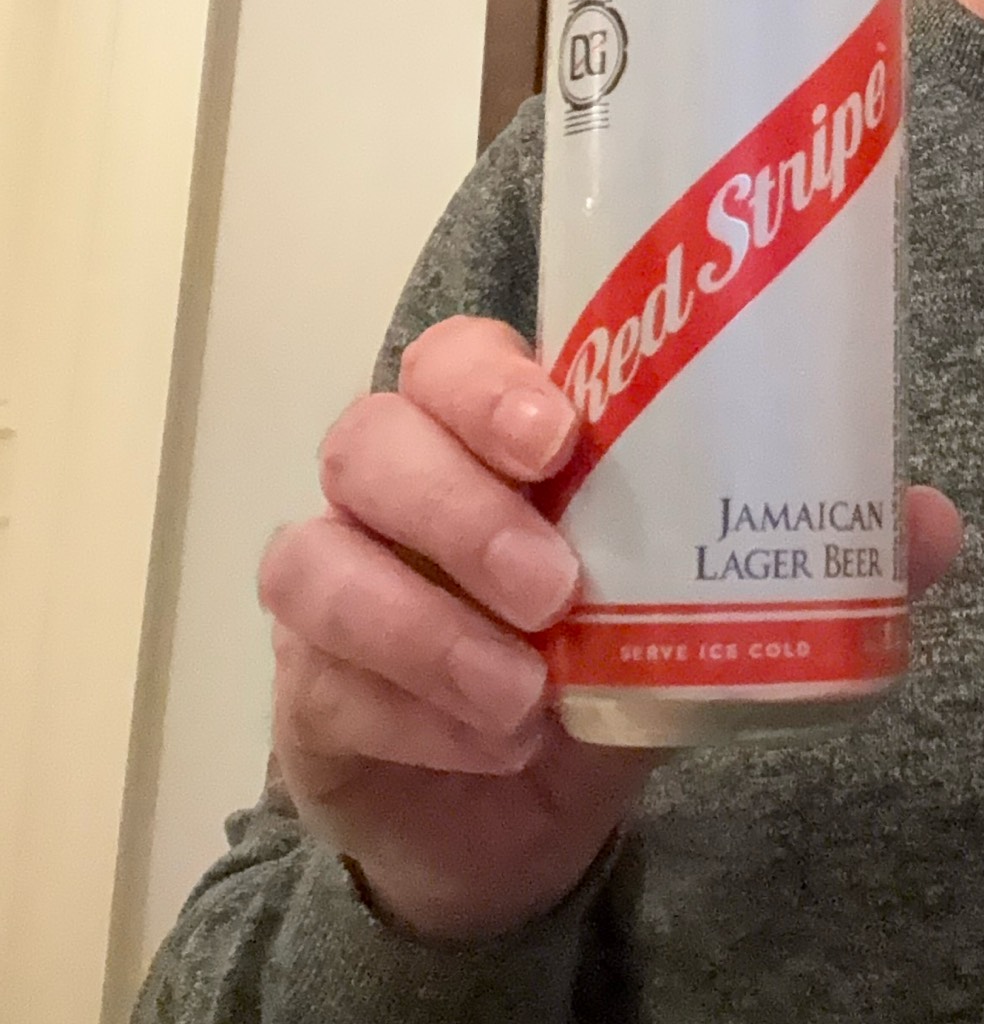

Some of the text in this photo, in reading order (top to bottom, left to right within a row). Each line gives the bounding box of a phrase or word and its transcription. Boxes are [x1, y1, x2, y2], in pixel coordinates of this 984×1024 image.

[564, 243, 694, 424] Red
[697, 60, 886, 294] Stripe
[718, 497, 884, 541] JAMAICAN
[695, 544, 883, 581] LAGER BEER
[619, 640, 811, 662] SERVE ICE COLD
